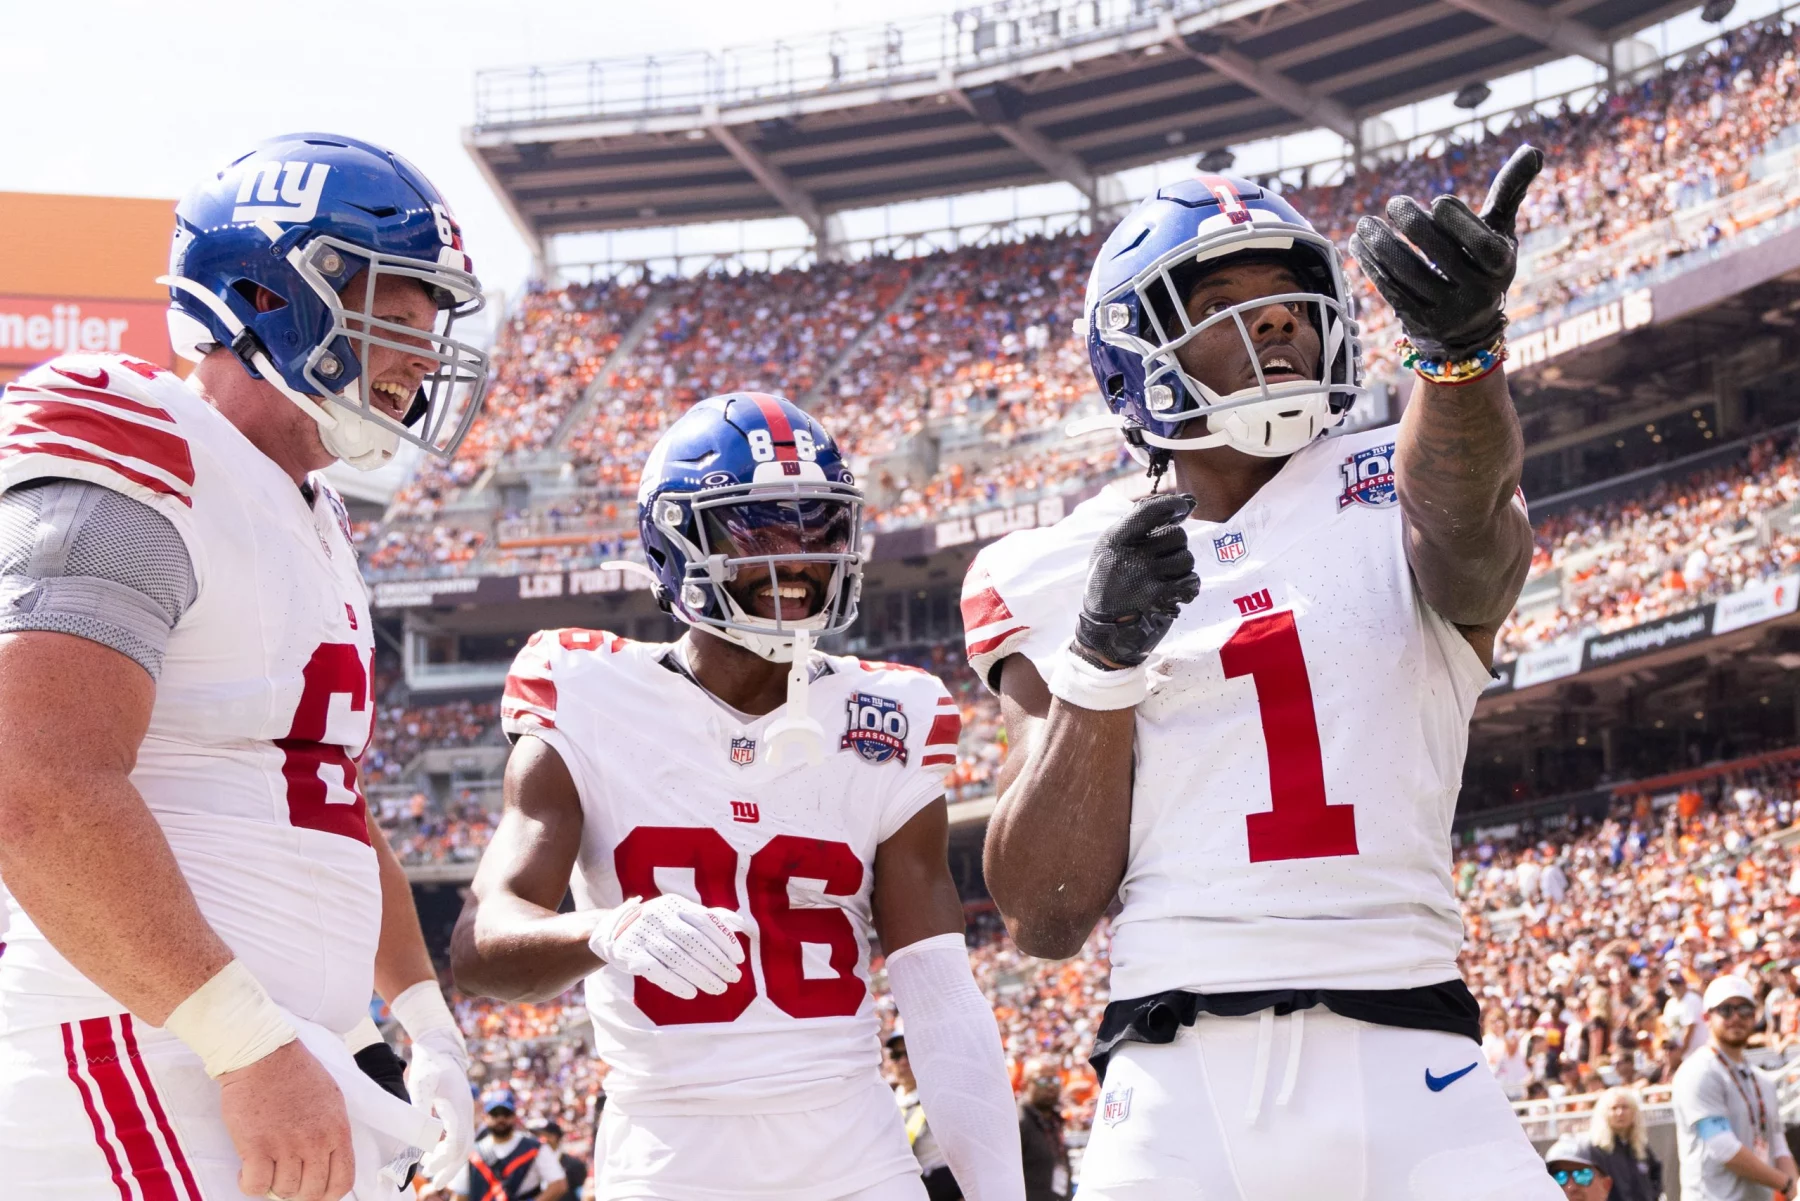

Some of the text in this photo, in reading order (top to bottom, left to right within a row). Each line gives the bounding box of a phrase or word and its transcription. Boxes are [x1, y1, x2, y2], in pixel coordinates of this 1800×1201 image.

[1214, 185, 1243, 213] 1
[1342, 455, 1395, 487] 10
[1351, 475, 1395, 493] SEASO
[1219, 543, 1244, 560] NFL
[1233, 588, 1273, 617] ny
[848, 702, 907, 741] 100
[851, 731, 900, 748] SEASONS
[1219, 609, 1359, 863] 1
[732, 748, 752, 762] NFL
[729, 800, 760, 823] ny
[1105, 1102, 1124, 1119] NFL
